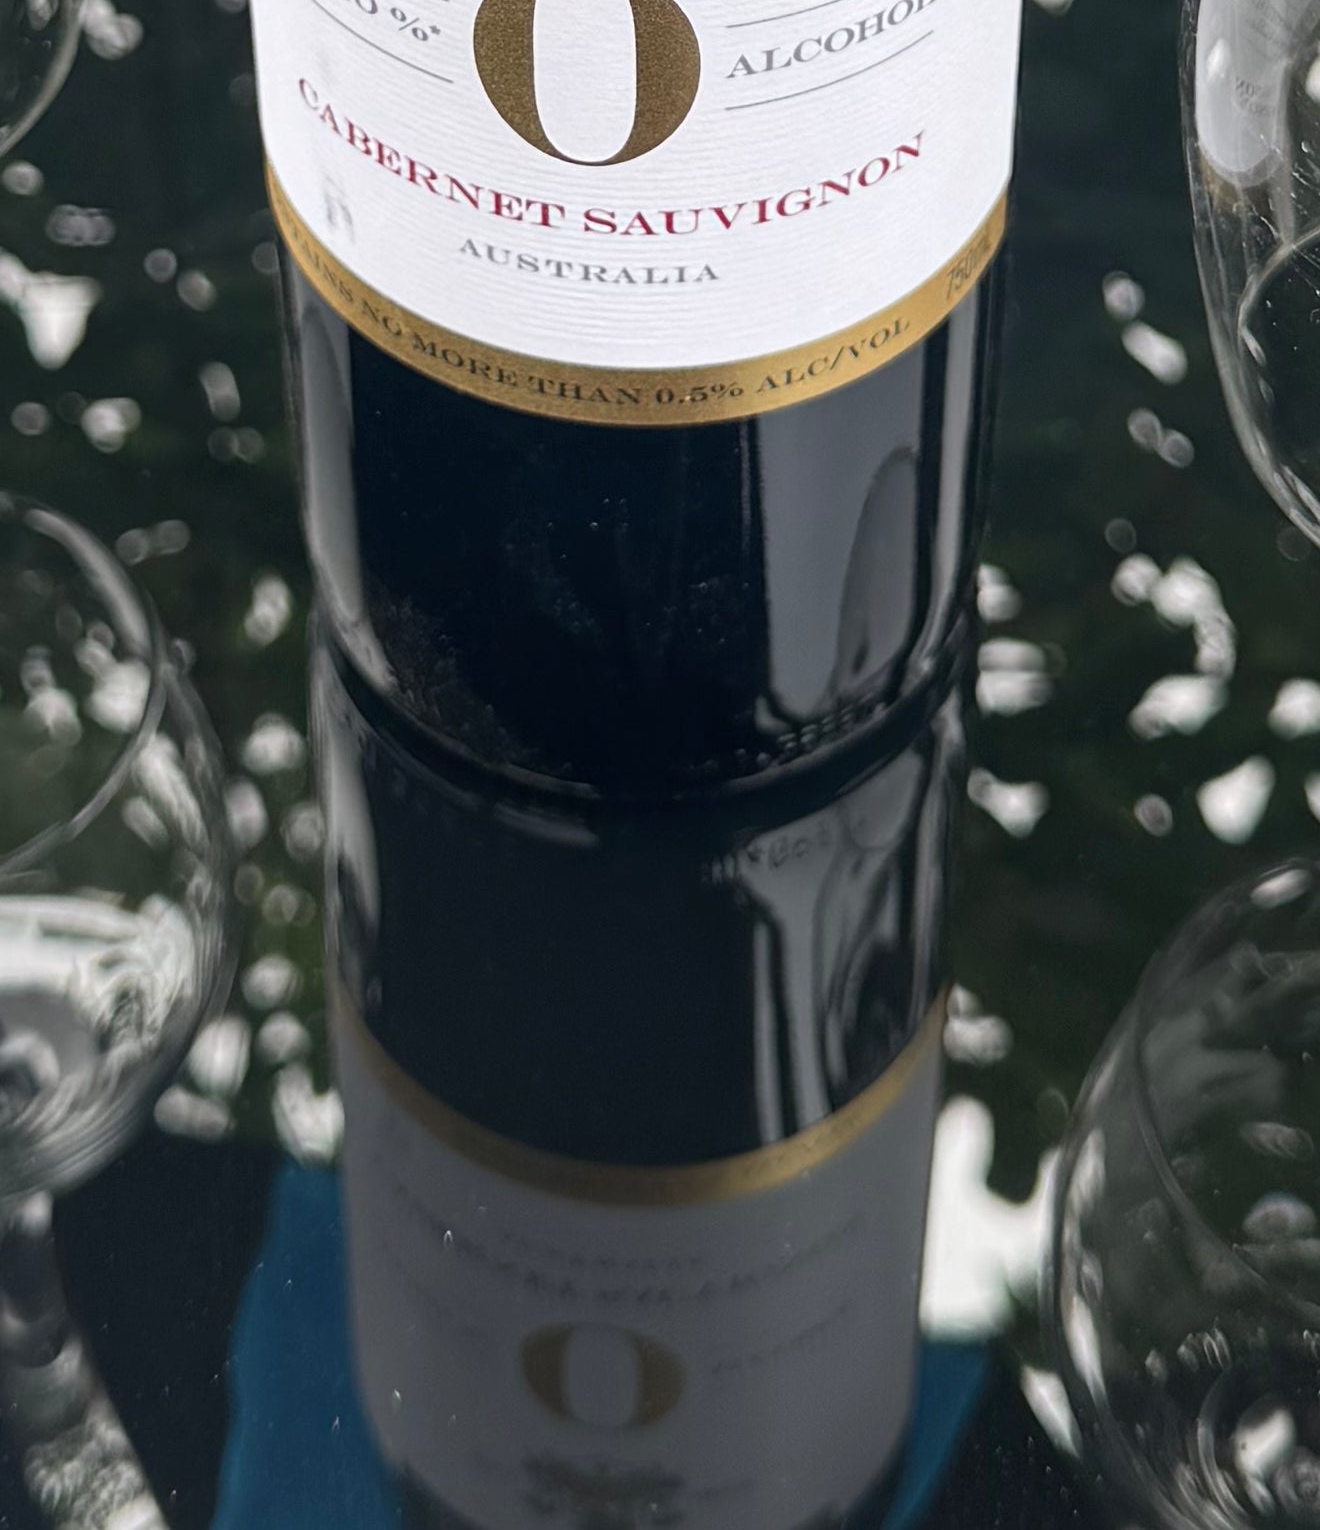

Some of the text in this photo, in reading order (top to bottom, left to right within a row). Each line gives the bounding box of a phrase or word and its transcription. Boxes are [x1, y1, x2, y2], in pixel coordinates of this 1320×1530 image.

[298, 78, 926, 236] CABERNET SAUVIGNON
[459, 238, 719, 285] AUSTRALIA
[361, 298, 404, 338] NO
[412, 331, 518, 387] MORE
[528, 375, 641, 406] THAN
[655, 383, 745, 407] 0.5%
[756, 316, 913, 394] ALC/VOL
